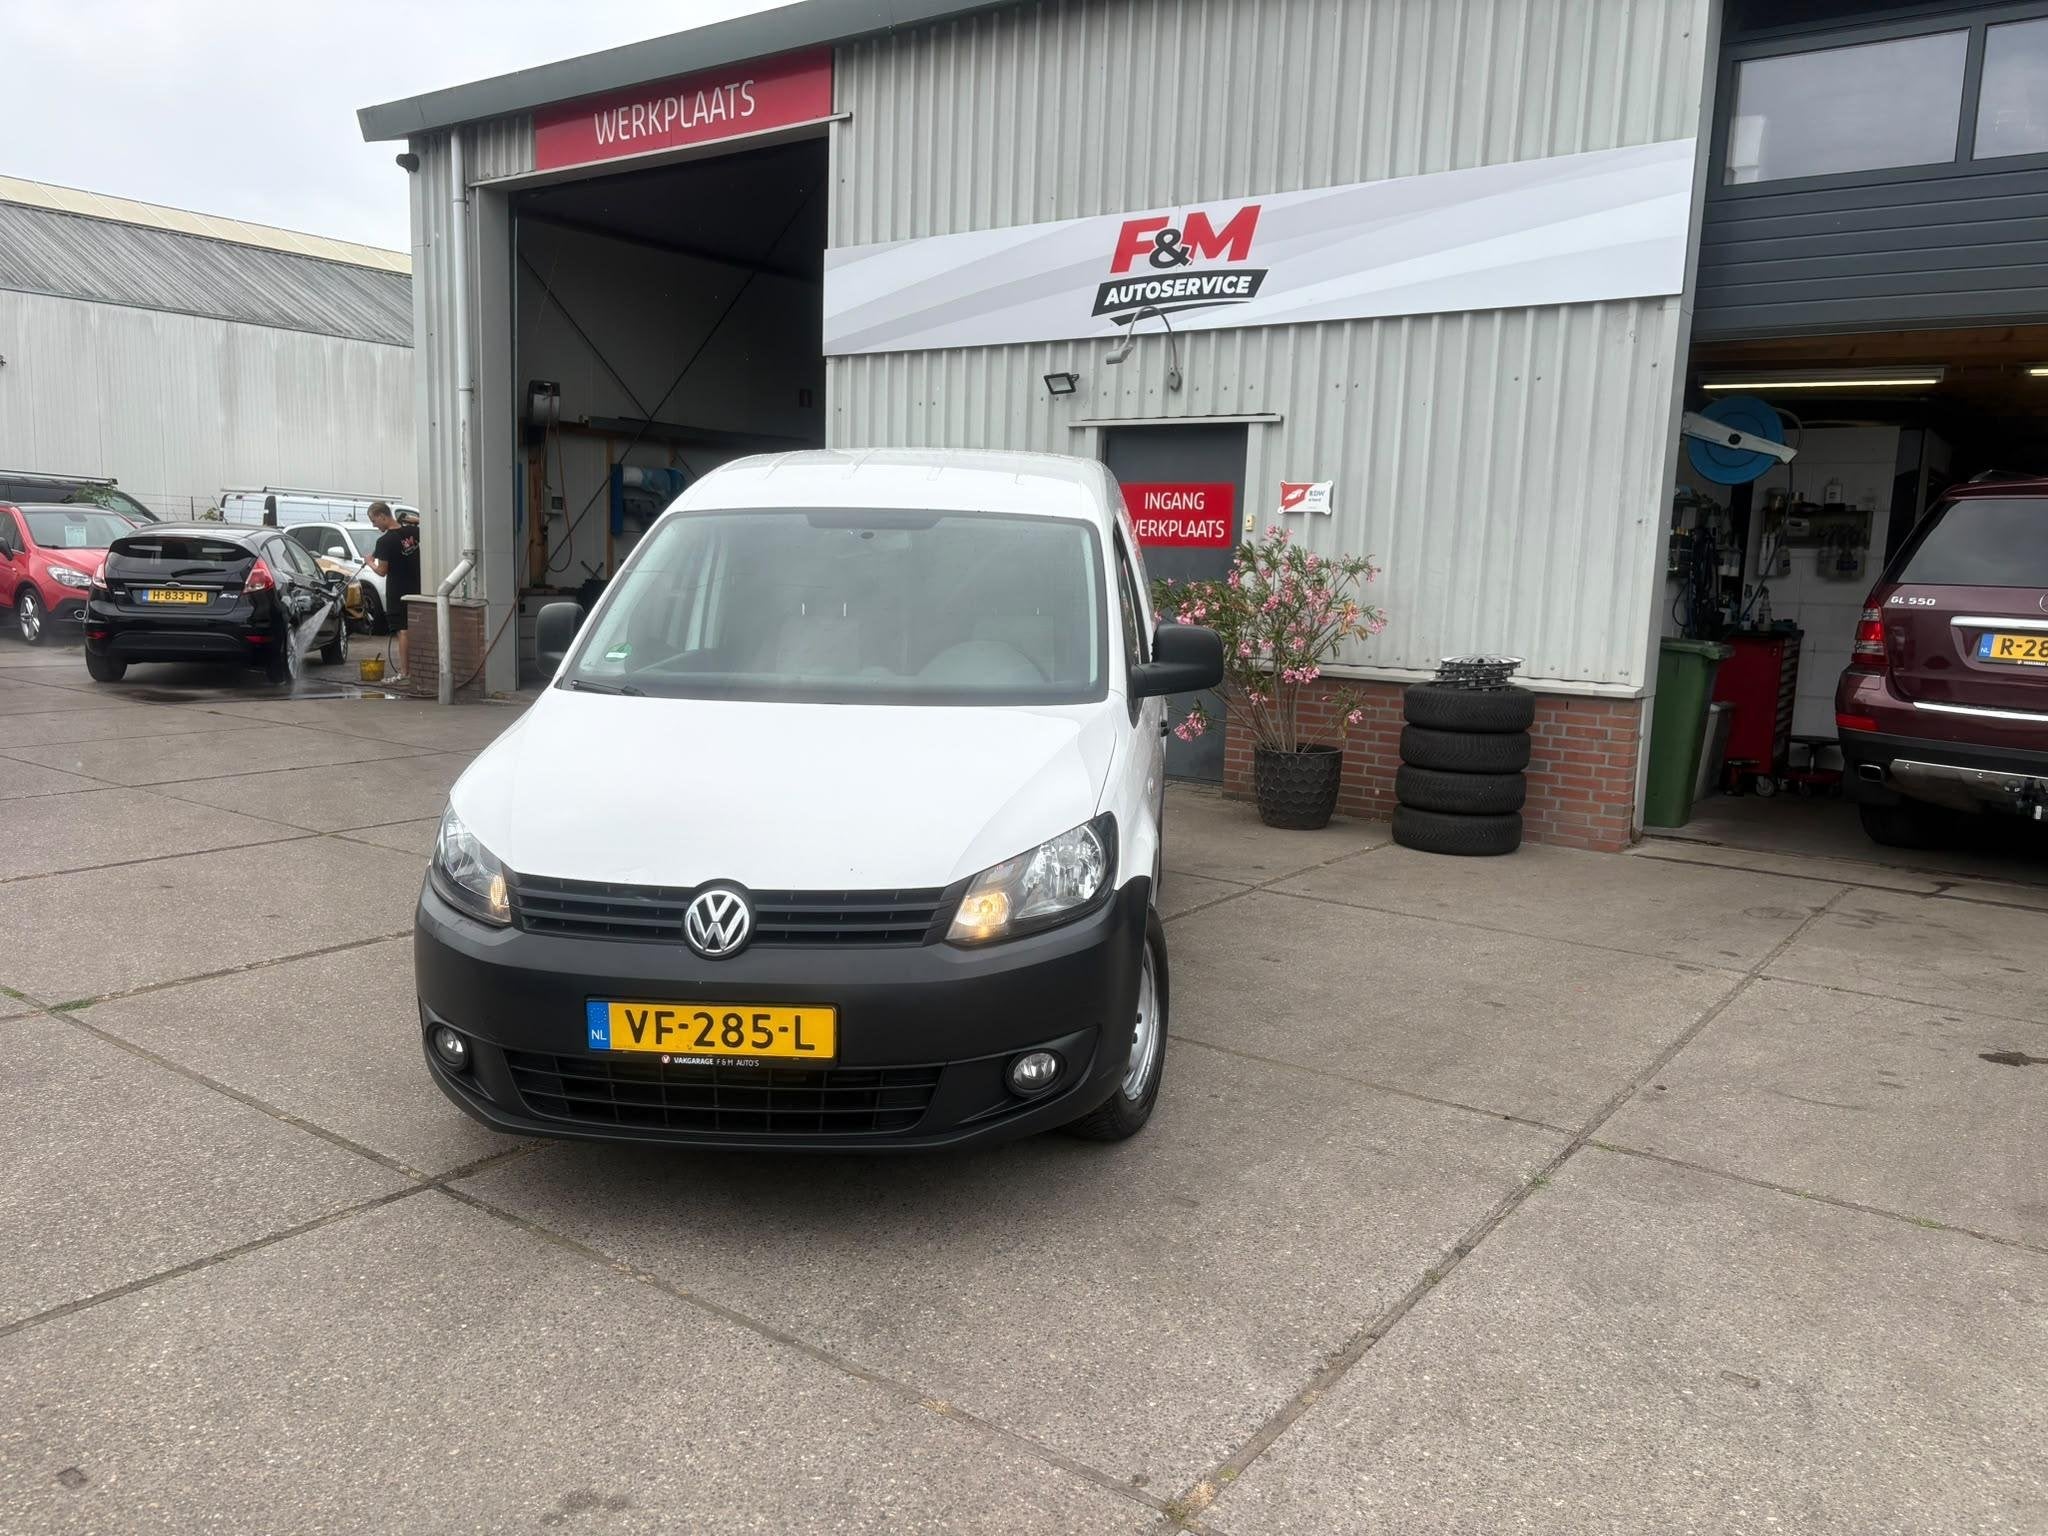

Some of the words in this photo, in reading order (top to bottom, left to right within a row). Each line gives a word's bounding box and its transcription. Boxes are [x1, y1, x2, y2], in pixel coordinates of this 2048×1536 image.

[594, 80, 755, 145] WERKPLAATS
[1110, 205, 1262, 274] F&M
[1104, 275, 1252, 306] AUTOSERVICE
[1144, 491, 1205, 510] INGANG
[152, 590, 204, 601] H-833-TP
[1891, 596, 1904, 604] GL
[1908, 597, 1936, 606] 550
[591, 1029, 607, 1041] NL
[624, 1009, 815, 1051] VF-285-L
[673, 1056, 714, 1065] VAKGARAGE
[736, 1059, 760, 1067] AUTO'S
